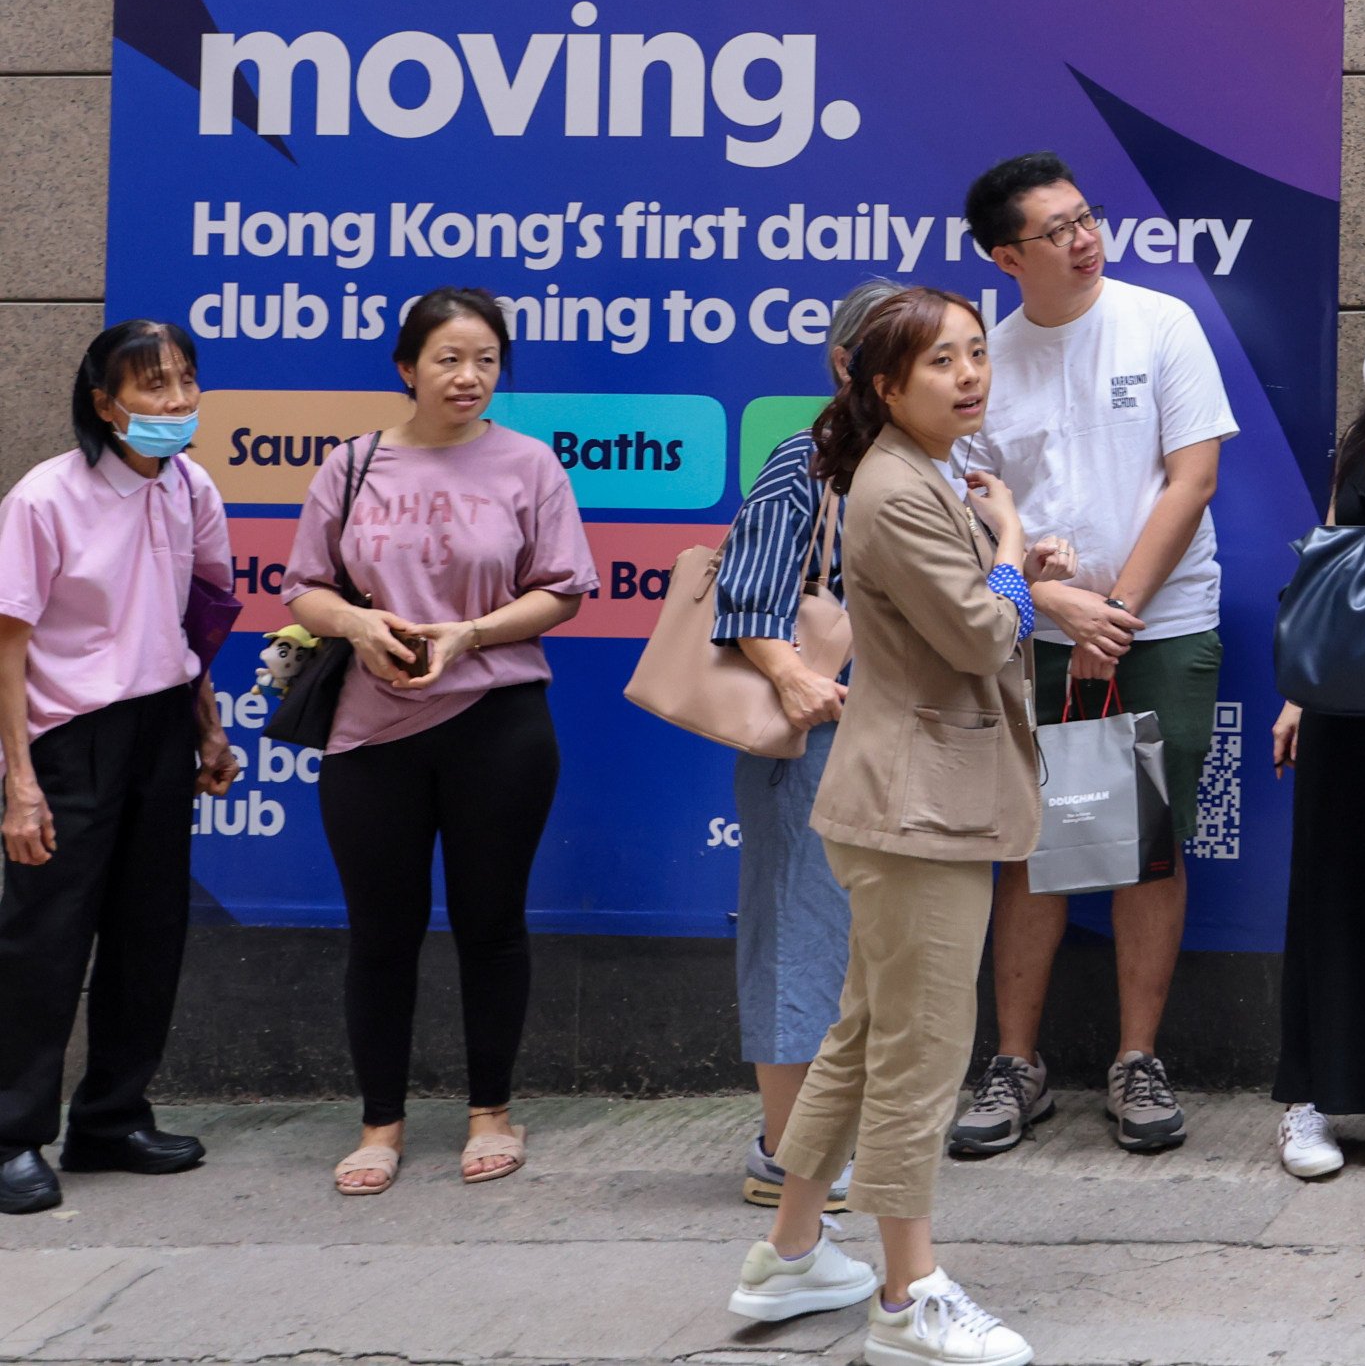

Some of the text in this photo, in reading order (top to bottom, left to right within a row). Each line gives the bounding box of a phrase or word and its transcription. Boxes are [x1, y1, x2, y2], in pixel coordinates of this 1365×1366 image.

[199, 1, 861, 168] moving.
[193, 201, 1253, 276] Hong Kong's first daily rvery
[189, 282, 329, 340] club
[342, 282, 387, 340] is
[399, 284, 651, 355] ming
[663, 290, 736, 344] to
[228, 427, 360, 467] Saun
[554, 431, 683, 472] Baths
[352, 491, 490, 526] WHAT
